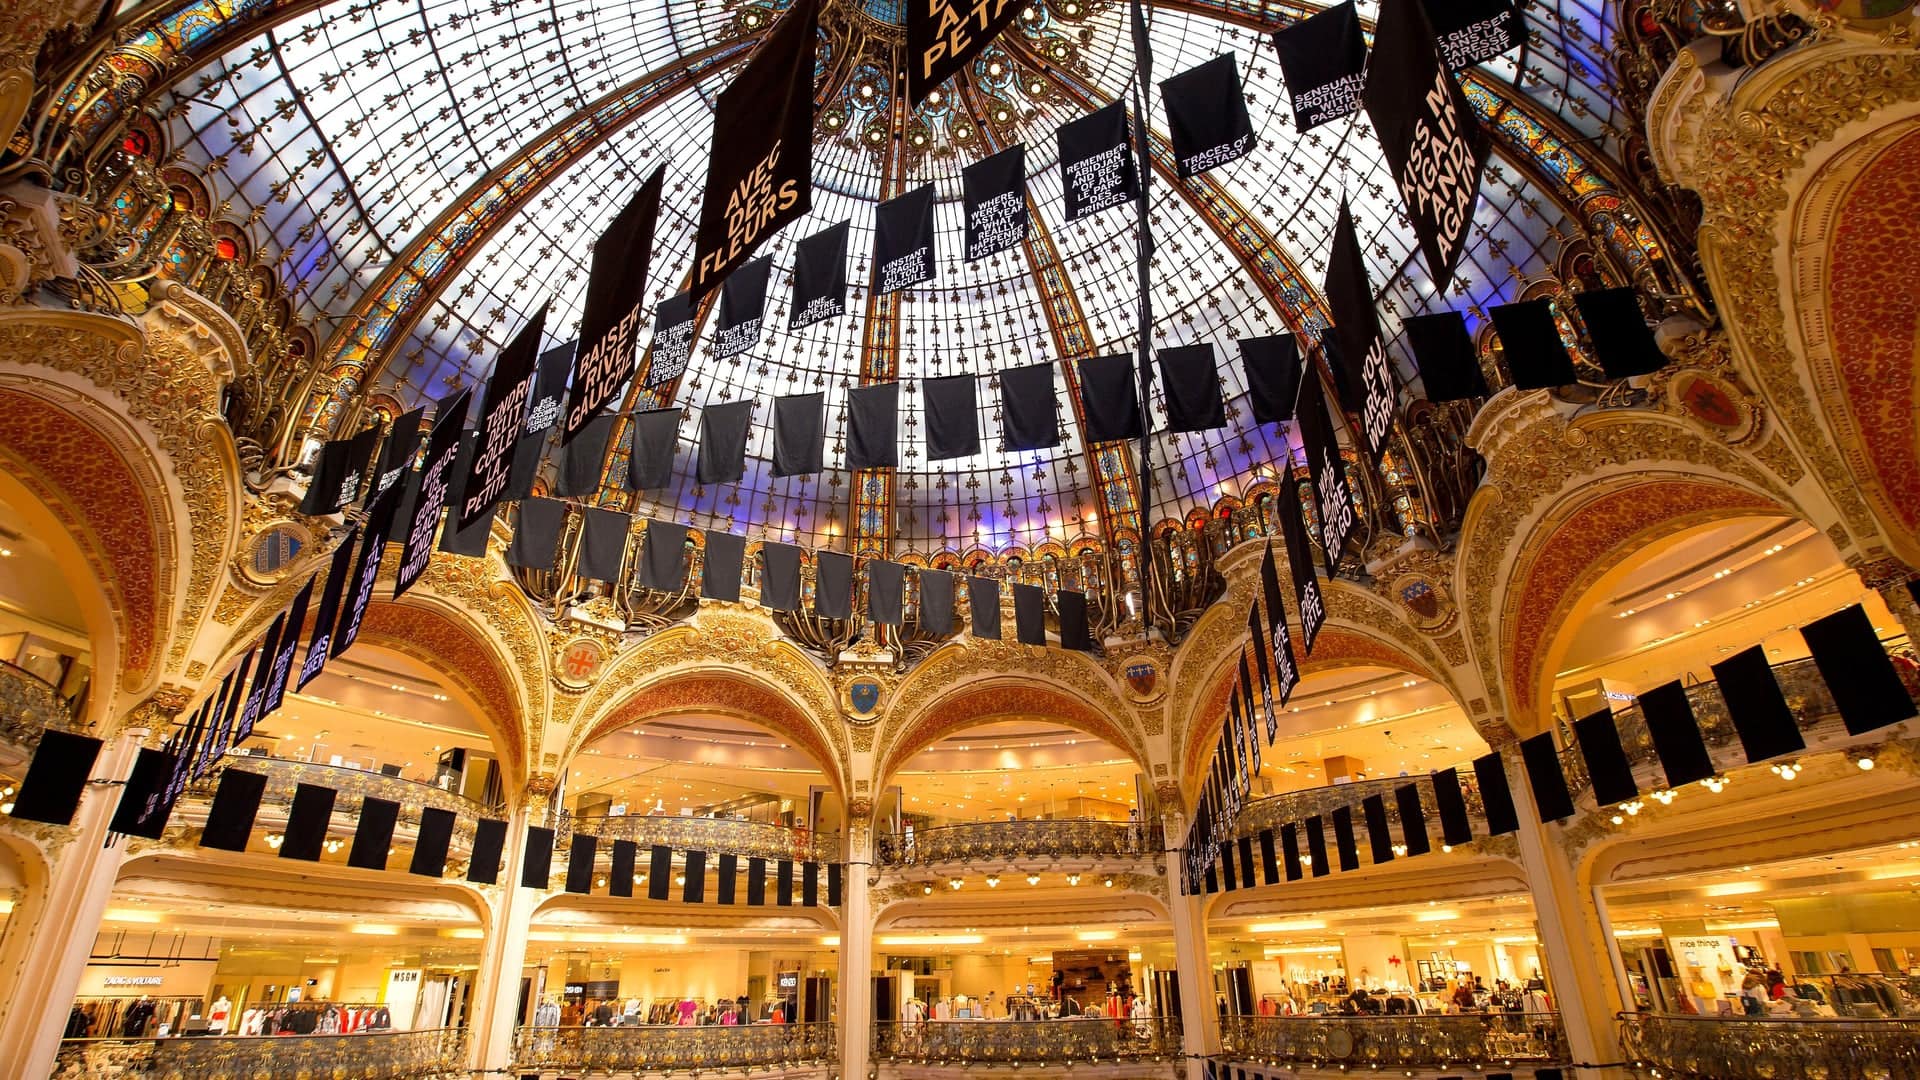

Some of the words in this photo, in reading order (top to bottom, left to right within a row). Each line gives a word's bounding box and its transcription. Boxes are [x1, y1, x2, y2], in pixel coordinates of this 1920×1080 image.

[1448, 10, 1511, 41] GLISSER
[1470, 39, 1509, 61] VENT
[1320, 92, 1355, 112] WITH
[1066, 142, 1127, 175] REMEMBER
[1182, 143, 1230, 167] TRACES
[1234, 133, 1249, 149] OF
[1191, 145, 1244, 174] ECSTASY
[1401, 118, 1429, 206] KISS
[724, 138, 781, 219] AVEC
[1072, 173, 1094, 189] AND
[1098, 158, 1125, 177] BEST
[1075, 153, 1120, 179] ABIDJAN
[1078, 190, 1090, 202] LE
[1093, 176, 1122, 194] PARC
[1080, 179, 1095, 192] OF
[1099, 171, 1118, 186] ALL
[1432, 136, 1465, 225] AND
[728, 174, 773, 240] DES
[971, 204, 999, 221] WERE
[1002, 195, 1023, 208] YOU
[978, 191, 1014, 210] WHERE
[1078, 192, 1127, 216] PRINCES
[1090, 190, 1111, 204] DES
[1437, 140, 1475, 267] AGAIN
[700, 178, 799, 285] FLEURS
[971, 213, 995, 230] LAST
[978, 221, 1014, 240] REALLY
[982, 214, 1012, 231] WHAT
[882, 247, 928, 273] L'INSTANT
[971, 243, 995, 259] LAST
[887, 256, 922, 278] FRAGILE
[900, 263, 925, 278] TOUT
[883, 271, 926, 293] BASCULE
[808, 296, 827, 308] UNE
[792, 318, 810, 328] UNE
[812, 305, 843, 321] PORTE
[579, 302, 640, 380] BAISER
[585, 337, 627, 392] RIVE
[1362, 335, 1382, 391] YOU
[569, 342, 634, 431] GAUCHE
[1364, 379, 1381, 434] ARE
[485, 456, 501, 486] LA
[464, 464, 510, 520] PETITE
[1338, 505, 1352, 538] GO
[410, 529, 433, 562] AND
[393, 972, 417, 982] MSGM
